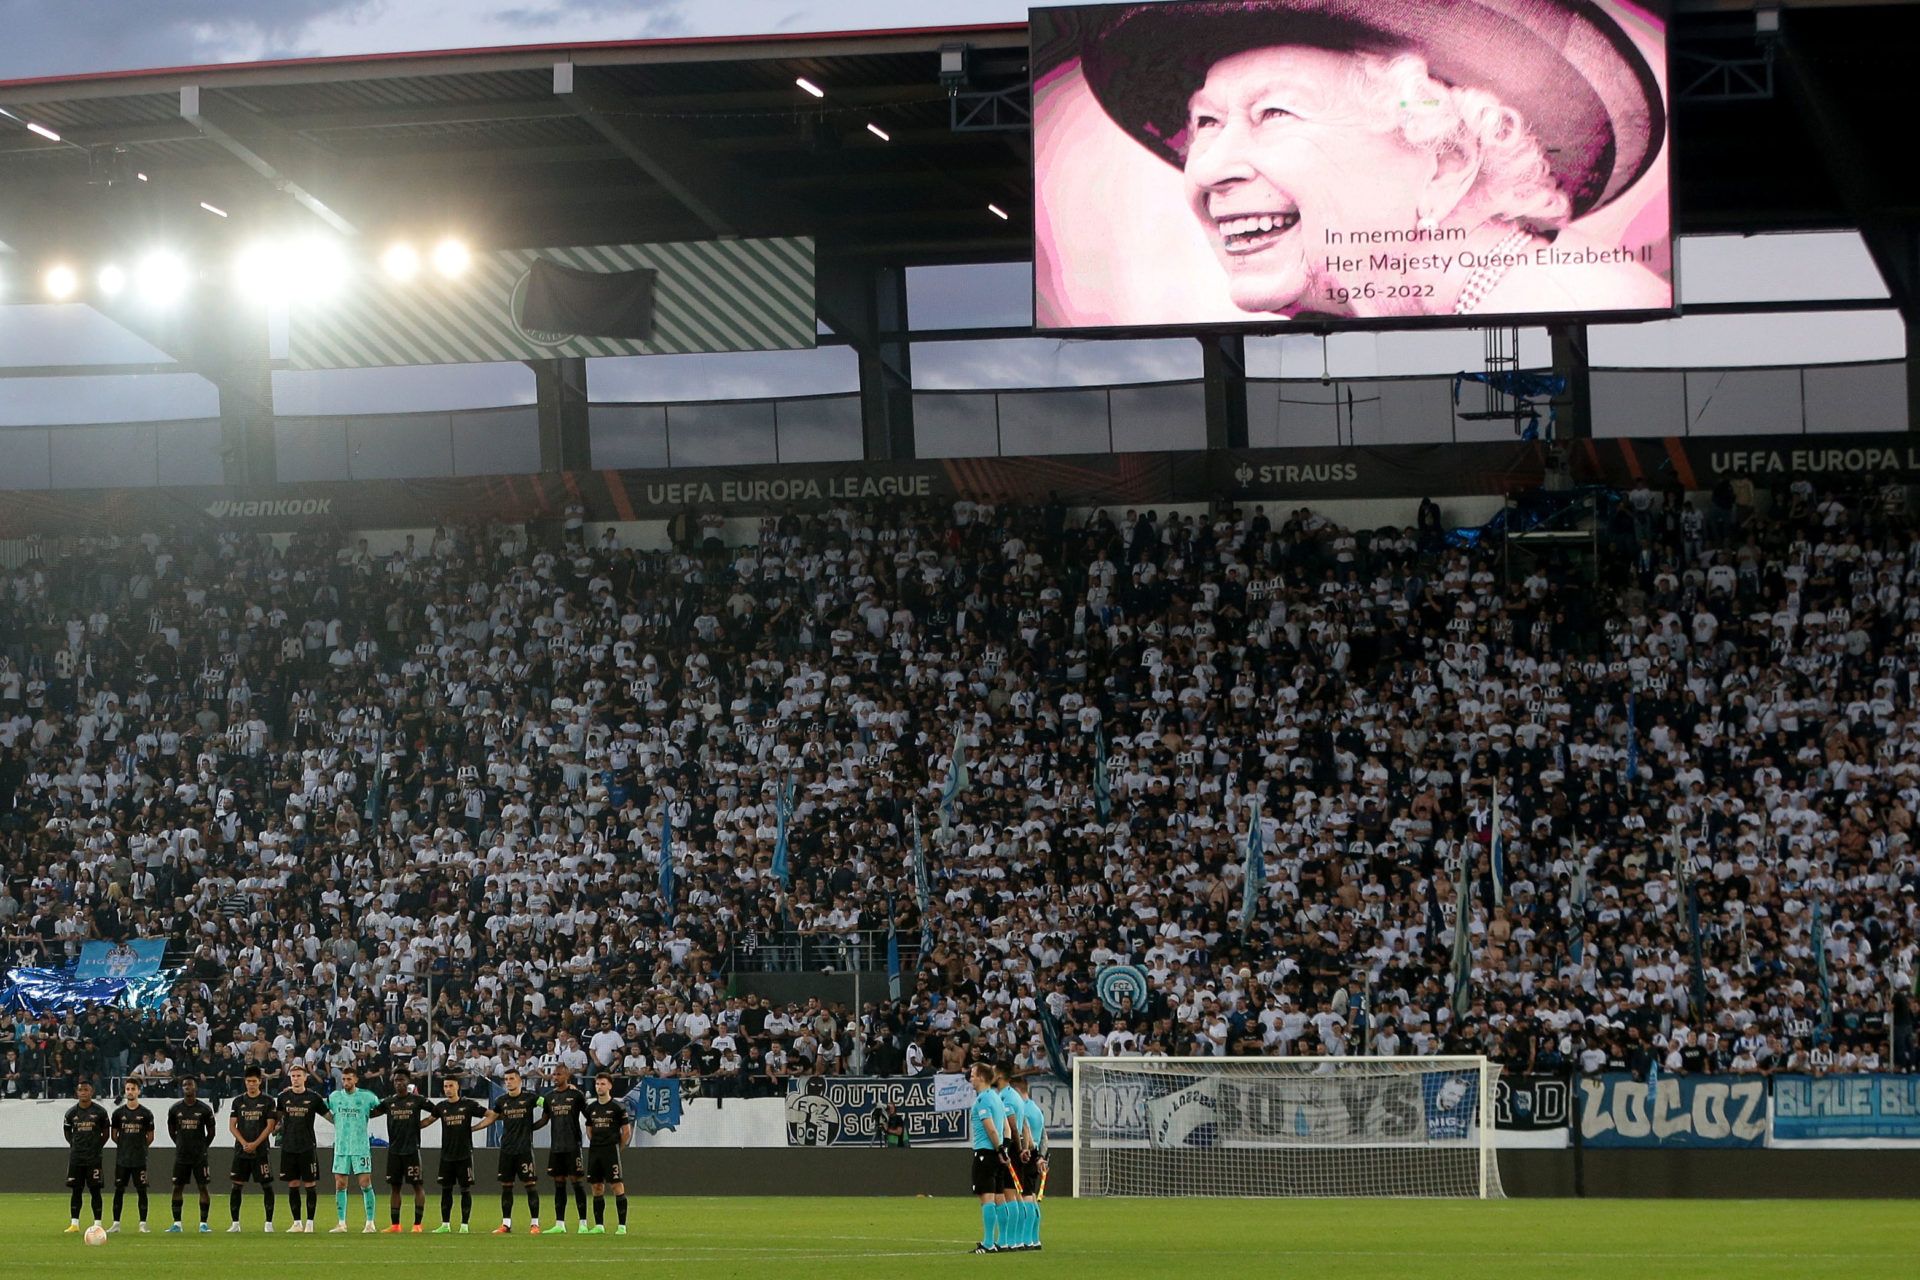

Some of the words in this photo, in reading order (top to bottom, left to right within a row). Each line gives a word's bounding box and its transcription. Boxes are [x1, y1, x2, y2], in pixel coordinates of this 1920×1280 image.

[1325, 228, 1343, 245] In
[1350, 226, 1466, 244] memoriam
[1326, 255, 1364, 273] Her
[1369, 254, 1451, 275] Majesty
[1458, 251, 1528, 269] Queen
[1536, 246, 1635, 265] Elizabeth
[1642, 246, 1652, 262] II
[1325, 284, 1435, 304] 1926-2022
[1711, 450, 1785, 474] UEFA
[1792, 448, 1900, 471] EUROPA
[1260, 463, 1358, 483] STRAUSS
[647, 484, 714, 505] UEFA
[722, 479, 823, 502] EUROPA
[1113, 982, 1130, 990] FCZ
[1775, 1078, 1874, 1117] BLAUE
[798, 1101, 830, 1117] FCZ
[260, 1163, 270, 1175] 18
[407, 1166, 420, 1176] 23
[521, 1162, 534, 1174] 34
[612, 1164, 620, 1175] 3
